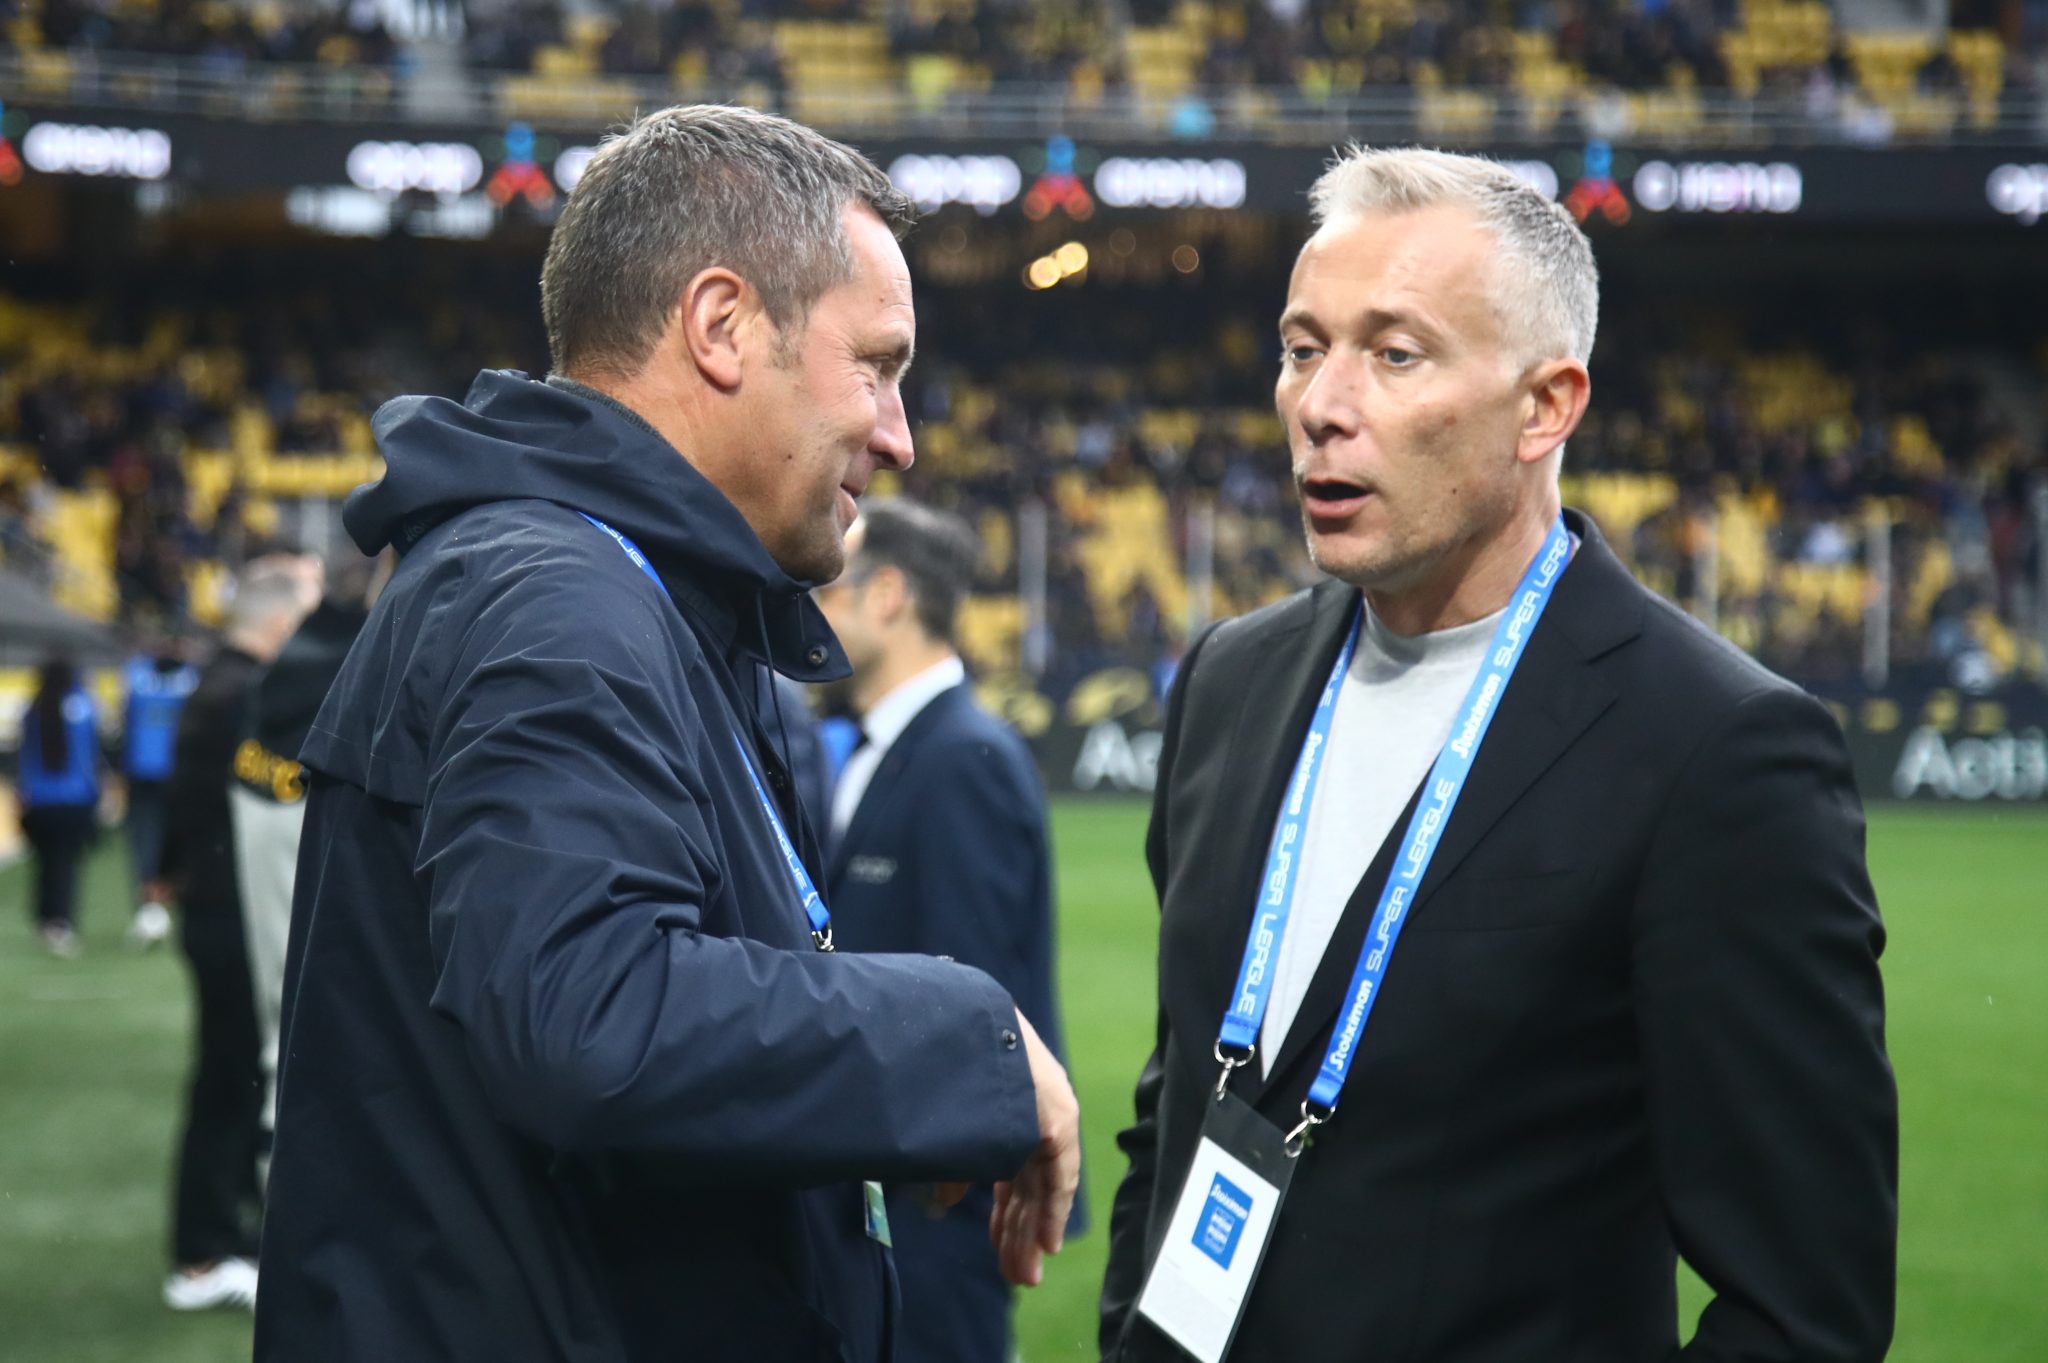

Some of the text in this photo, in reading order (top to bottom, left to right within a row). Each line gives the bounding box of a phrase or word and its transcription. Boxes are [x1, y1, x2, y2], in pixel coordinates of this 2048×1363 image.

[1493, 590, 1541, 668] SUPER
[1267, 823, 1297, 906] SUPER
[1366, 886, 1409, 972] SUPER
[1402, 777, 1455, 880] LEAGUE
[1237, 913, 1278, 1017] LEAGUE
